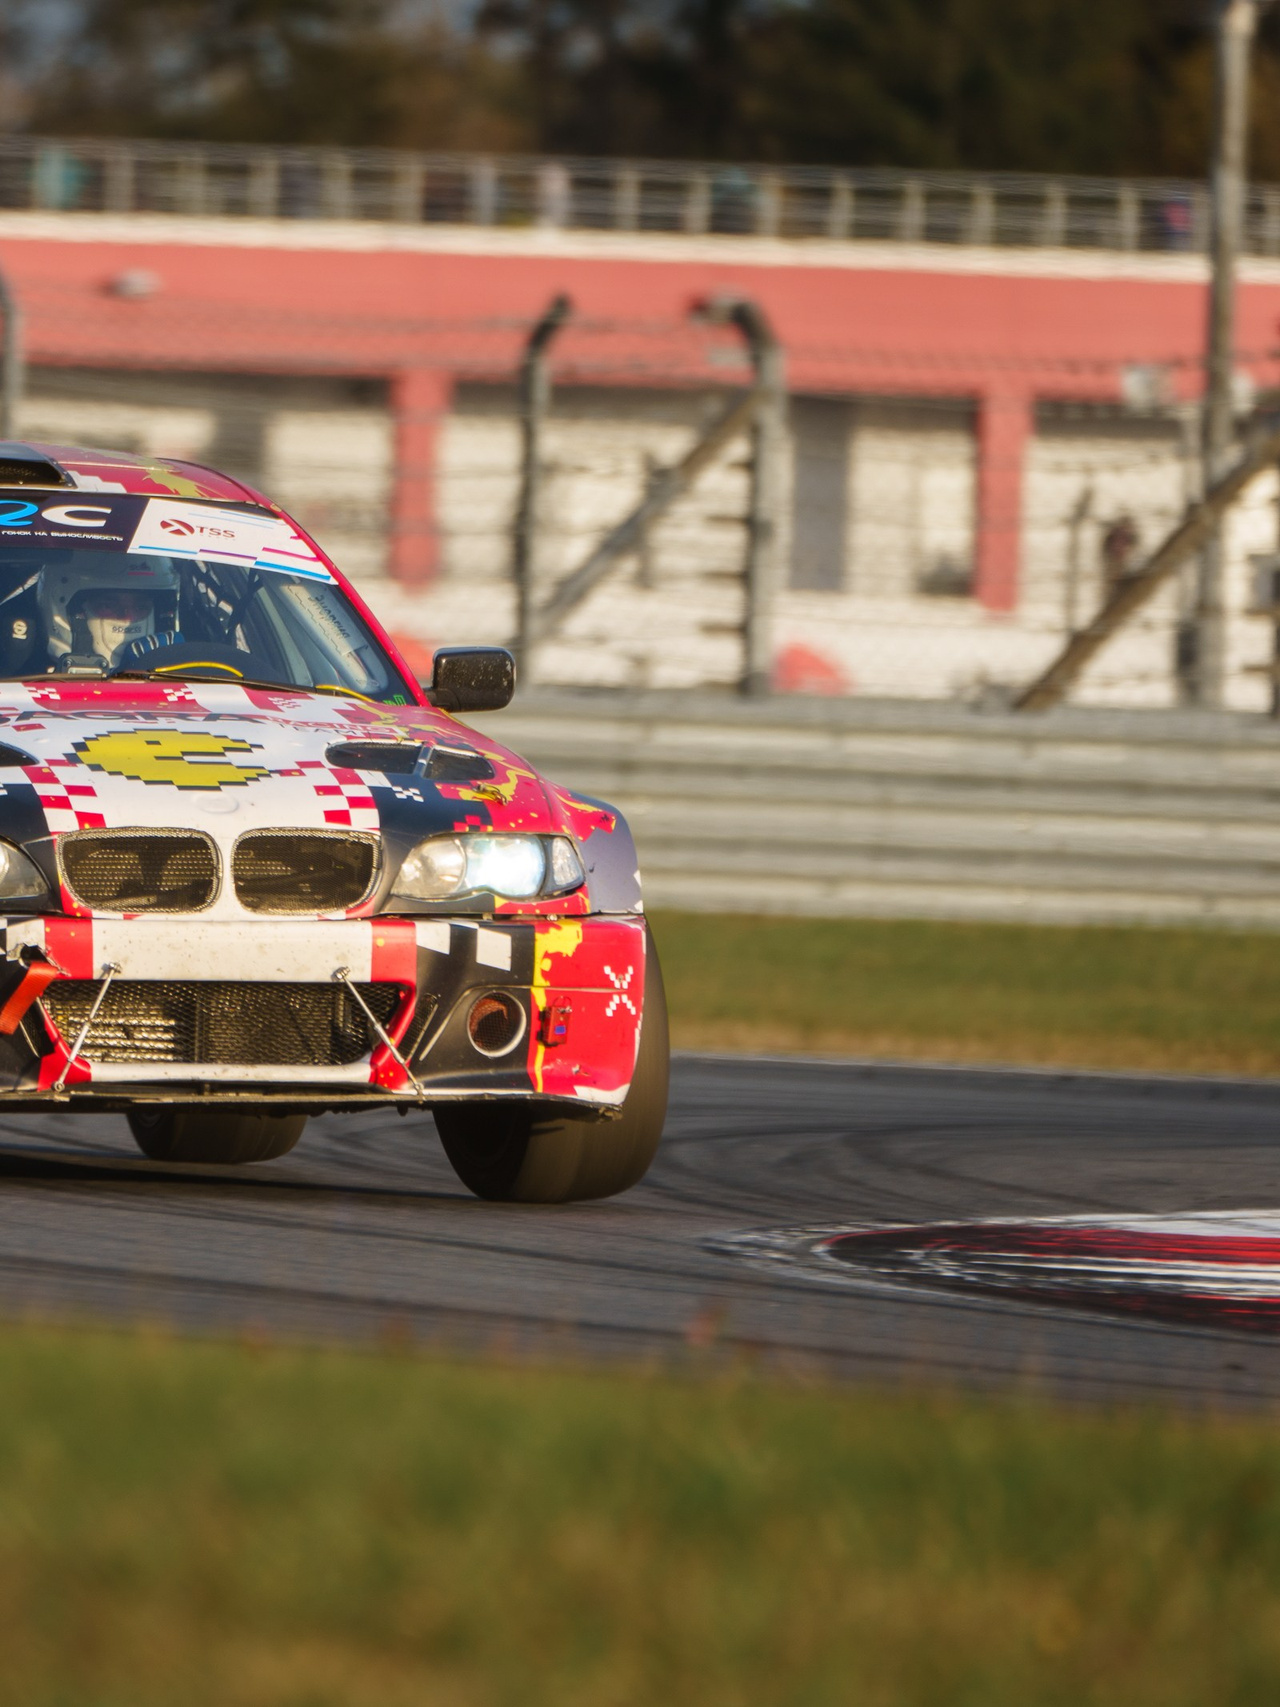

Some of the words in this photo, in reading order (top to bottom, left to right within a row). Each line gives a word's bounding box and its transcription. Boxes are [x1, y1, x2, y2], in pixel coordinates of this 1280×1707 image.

[50, 532, 124, 542] ВЫНОСЛИВОСТЬ
[195, 525, 236, 538] TSS
[269, 716, 392, 733] RACING
